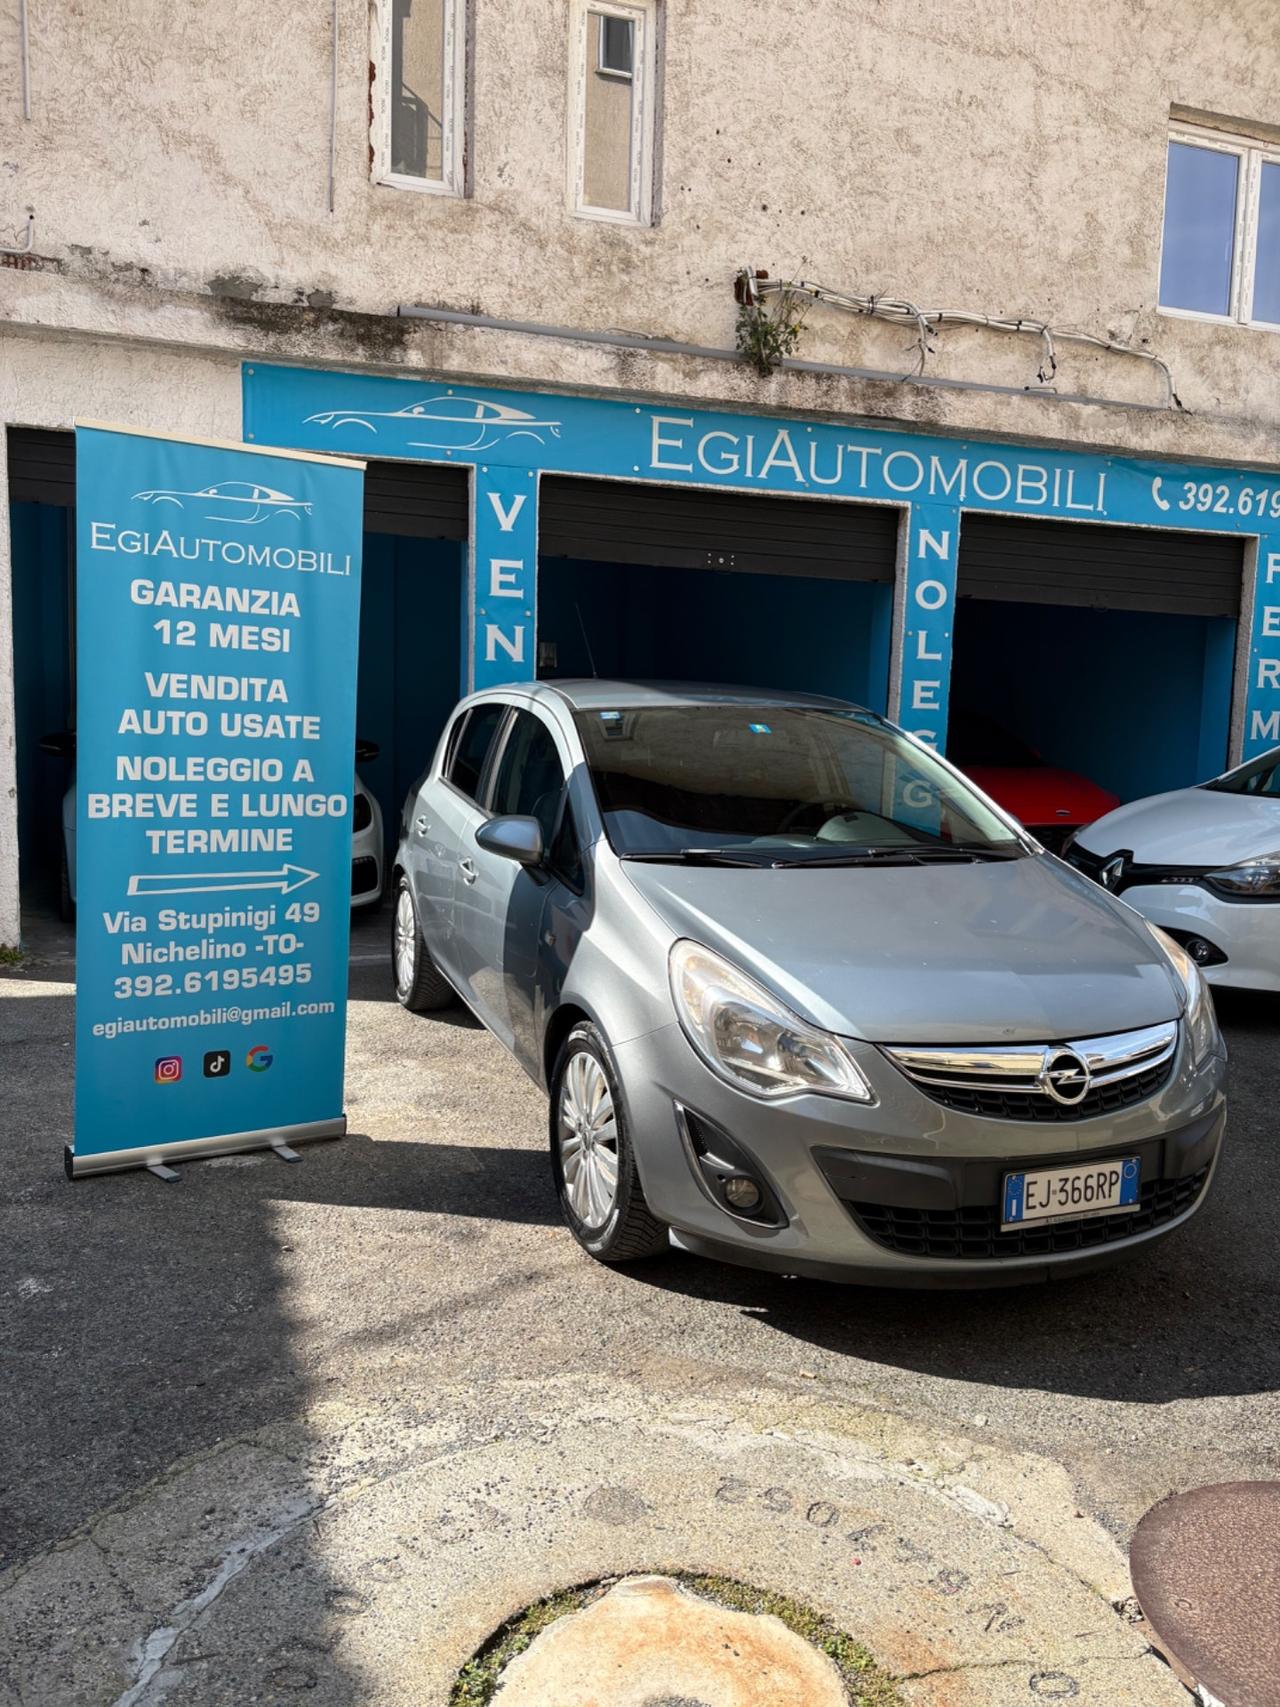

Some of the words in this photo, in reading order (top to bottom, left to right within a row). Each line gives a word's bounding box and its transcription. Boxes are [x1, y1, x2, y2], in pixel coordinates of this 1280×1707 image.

[131, 579, 301, 618] GARANZIA
[153, 619, 196, 647] 12
[209, 623, 290, 653] MESI
[144, 672, 289, 703] VENDITA
[118, 709, 208, 736] AUTO
[221, 713, 321, 740] USATE
[116, 756, 283, 782] NOLEGGIO
[292, 759, 315, 782] A
[88, 793, 198, 819] BREVE
[211, 794, 229, 818] E
[242, 794, 347, 818] LUNGO
[145, 828, 293, 854] TERMINE
[103, 911, 147, 934] Via
[158, 904, 276, 934] Stupinigi
[284, 902, 320, 923] 49
[121, 939, 246, 965] Nichelino
[255, 933, 304, 955] -TO-
[114, 963, 312, 999] 392.6195495
[92, 1001, 335, 1039] egiautomobili@gmail.com
